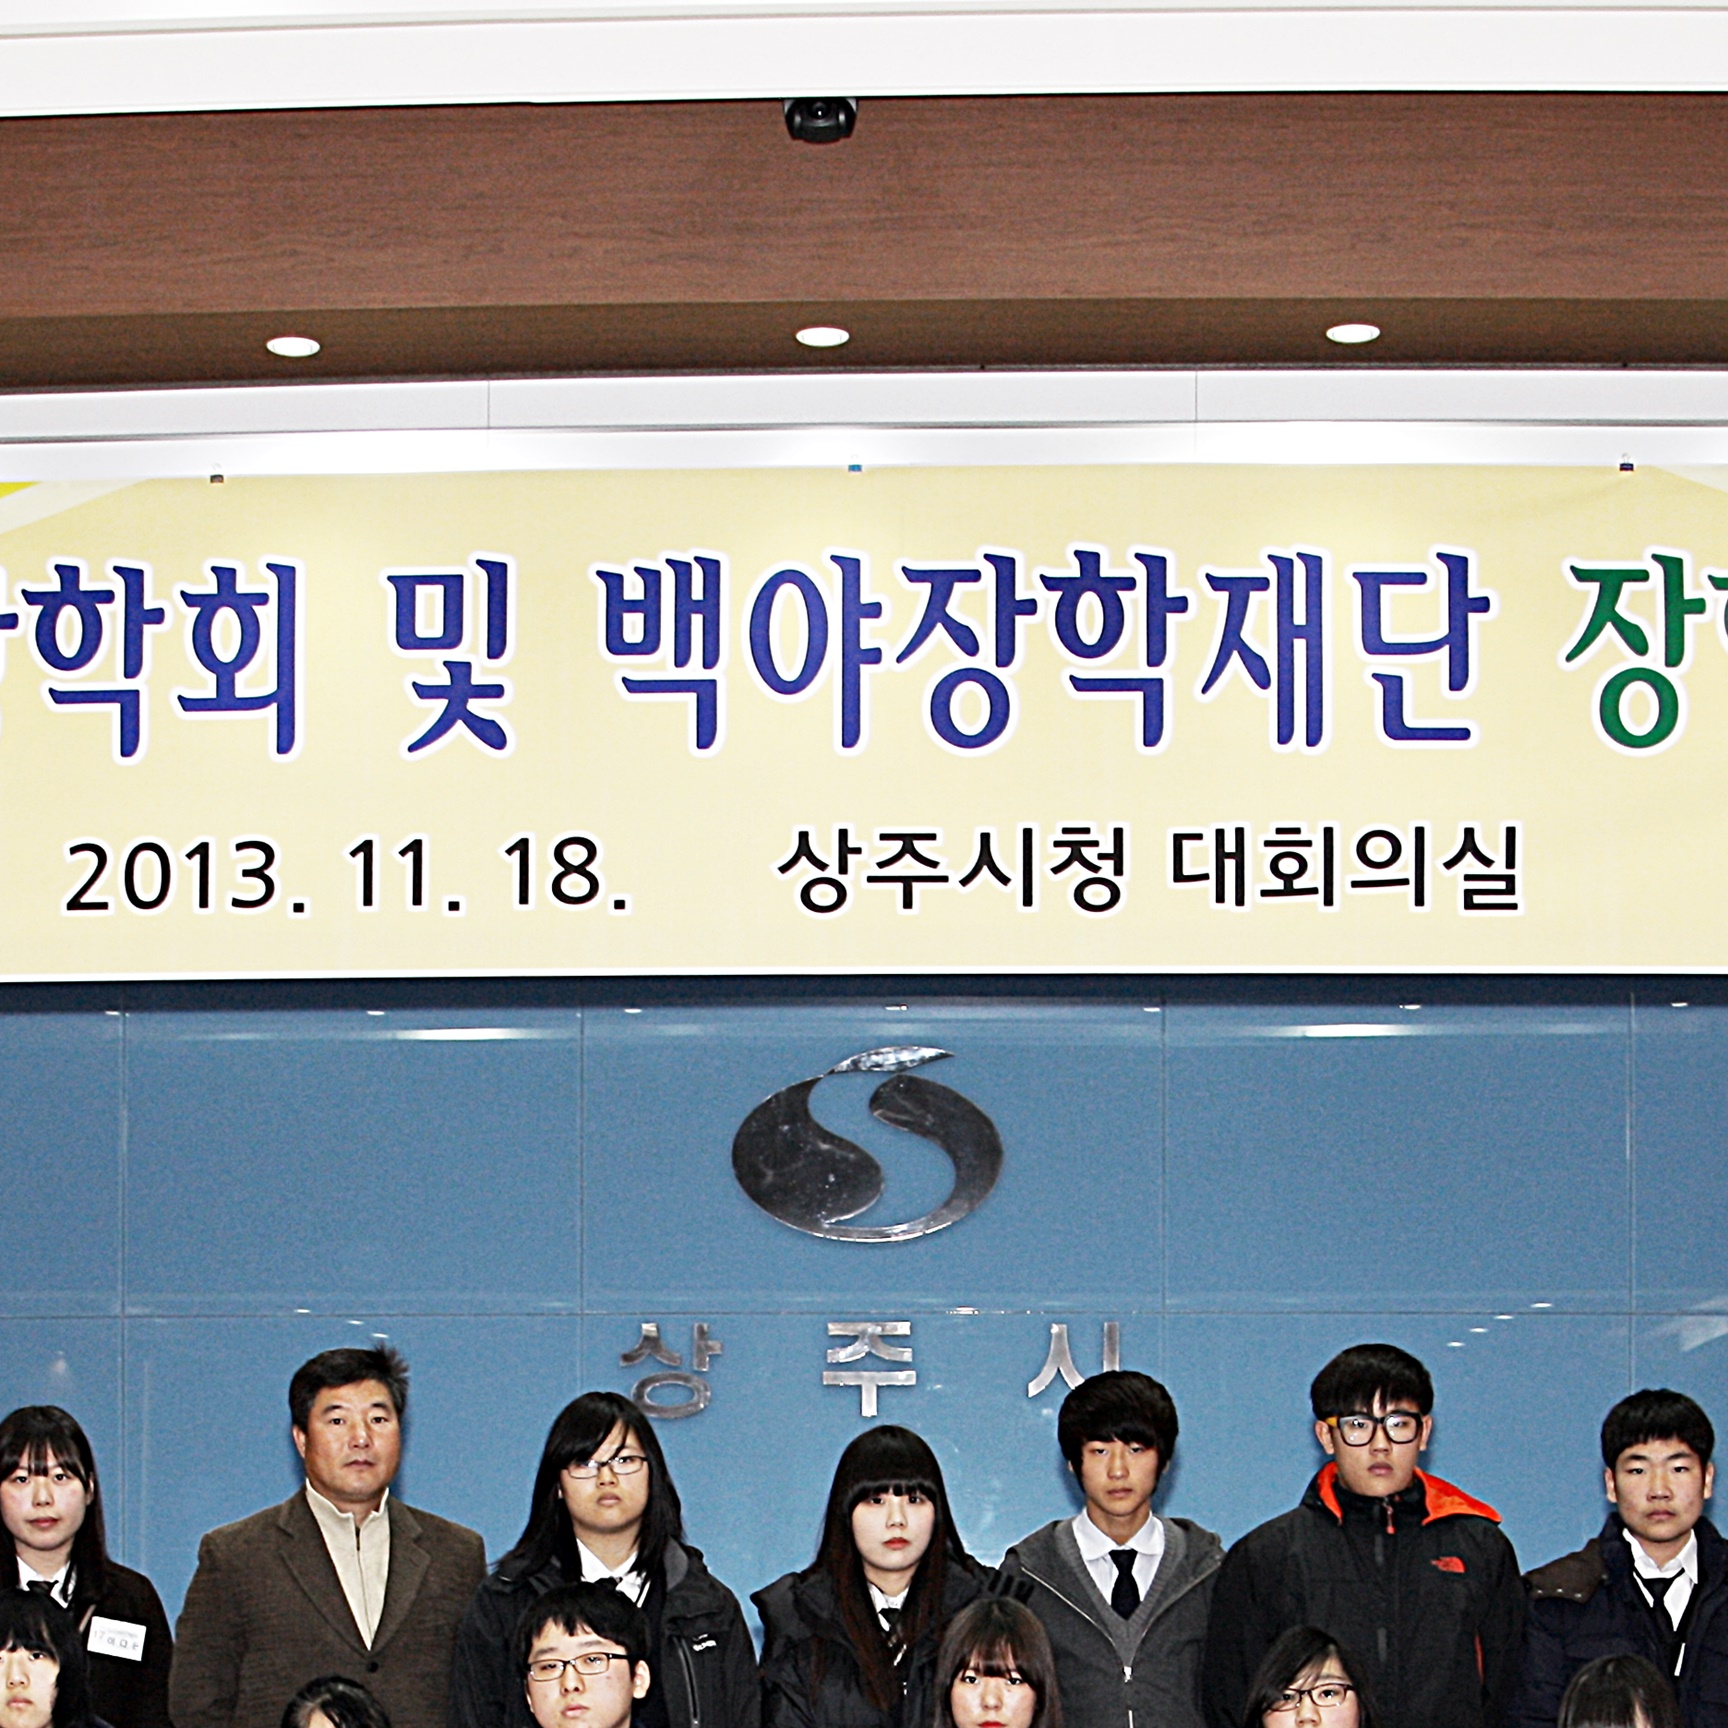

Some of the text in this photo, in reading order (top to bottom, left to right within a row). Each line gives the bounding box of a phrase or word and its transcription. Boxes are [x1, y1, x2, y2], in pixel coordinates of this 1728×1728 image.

[387, 558, 508, 752] 및
[595, 549, 1492, 749] 백야장학재단
[67, 836, 626, 913] 2013. 11. 18.
[777, 825, 1519, 913] 상주시청 대회의실
